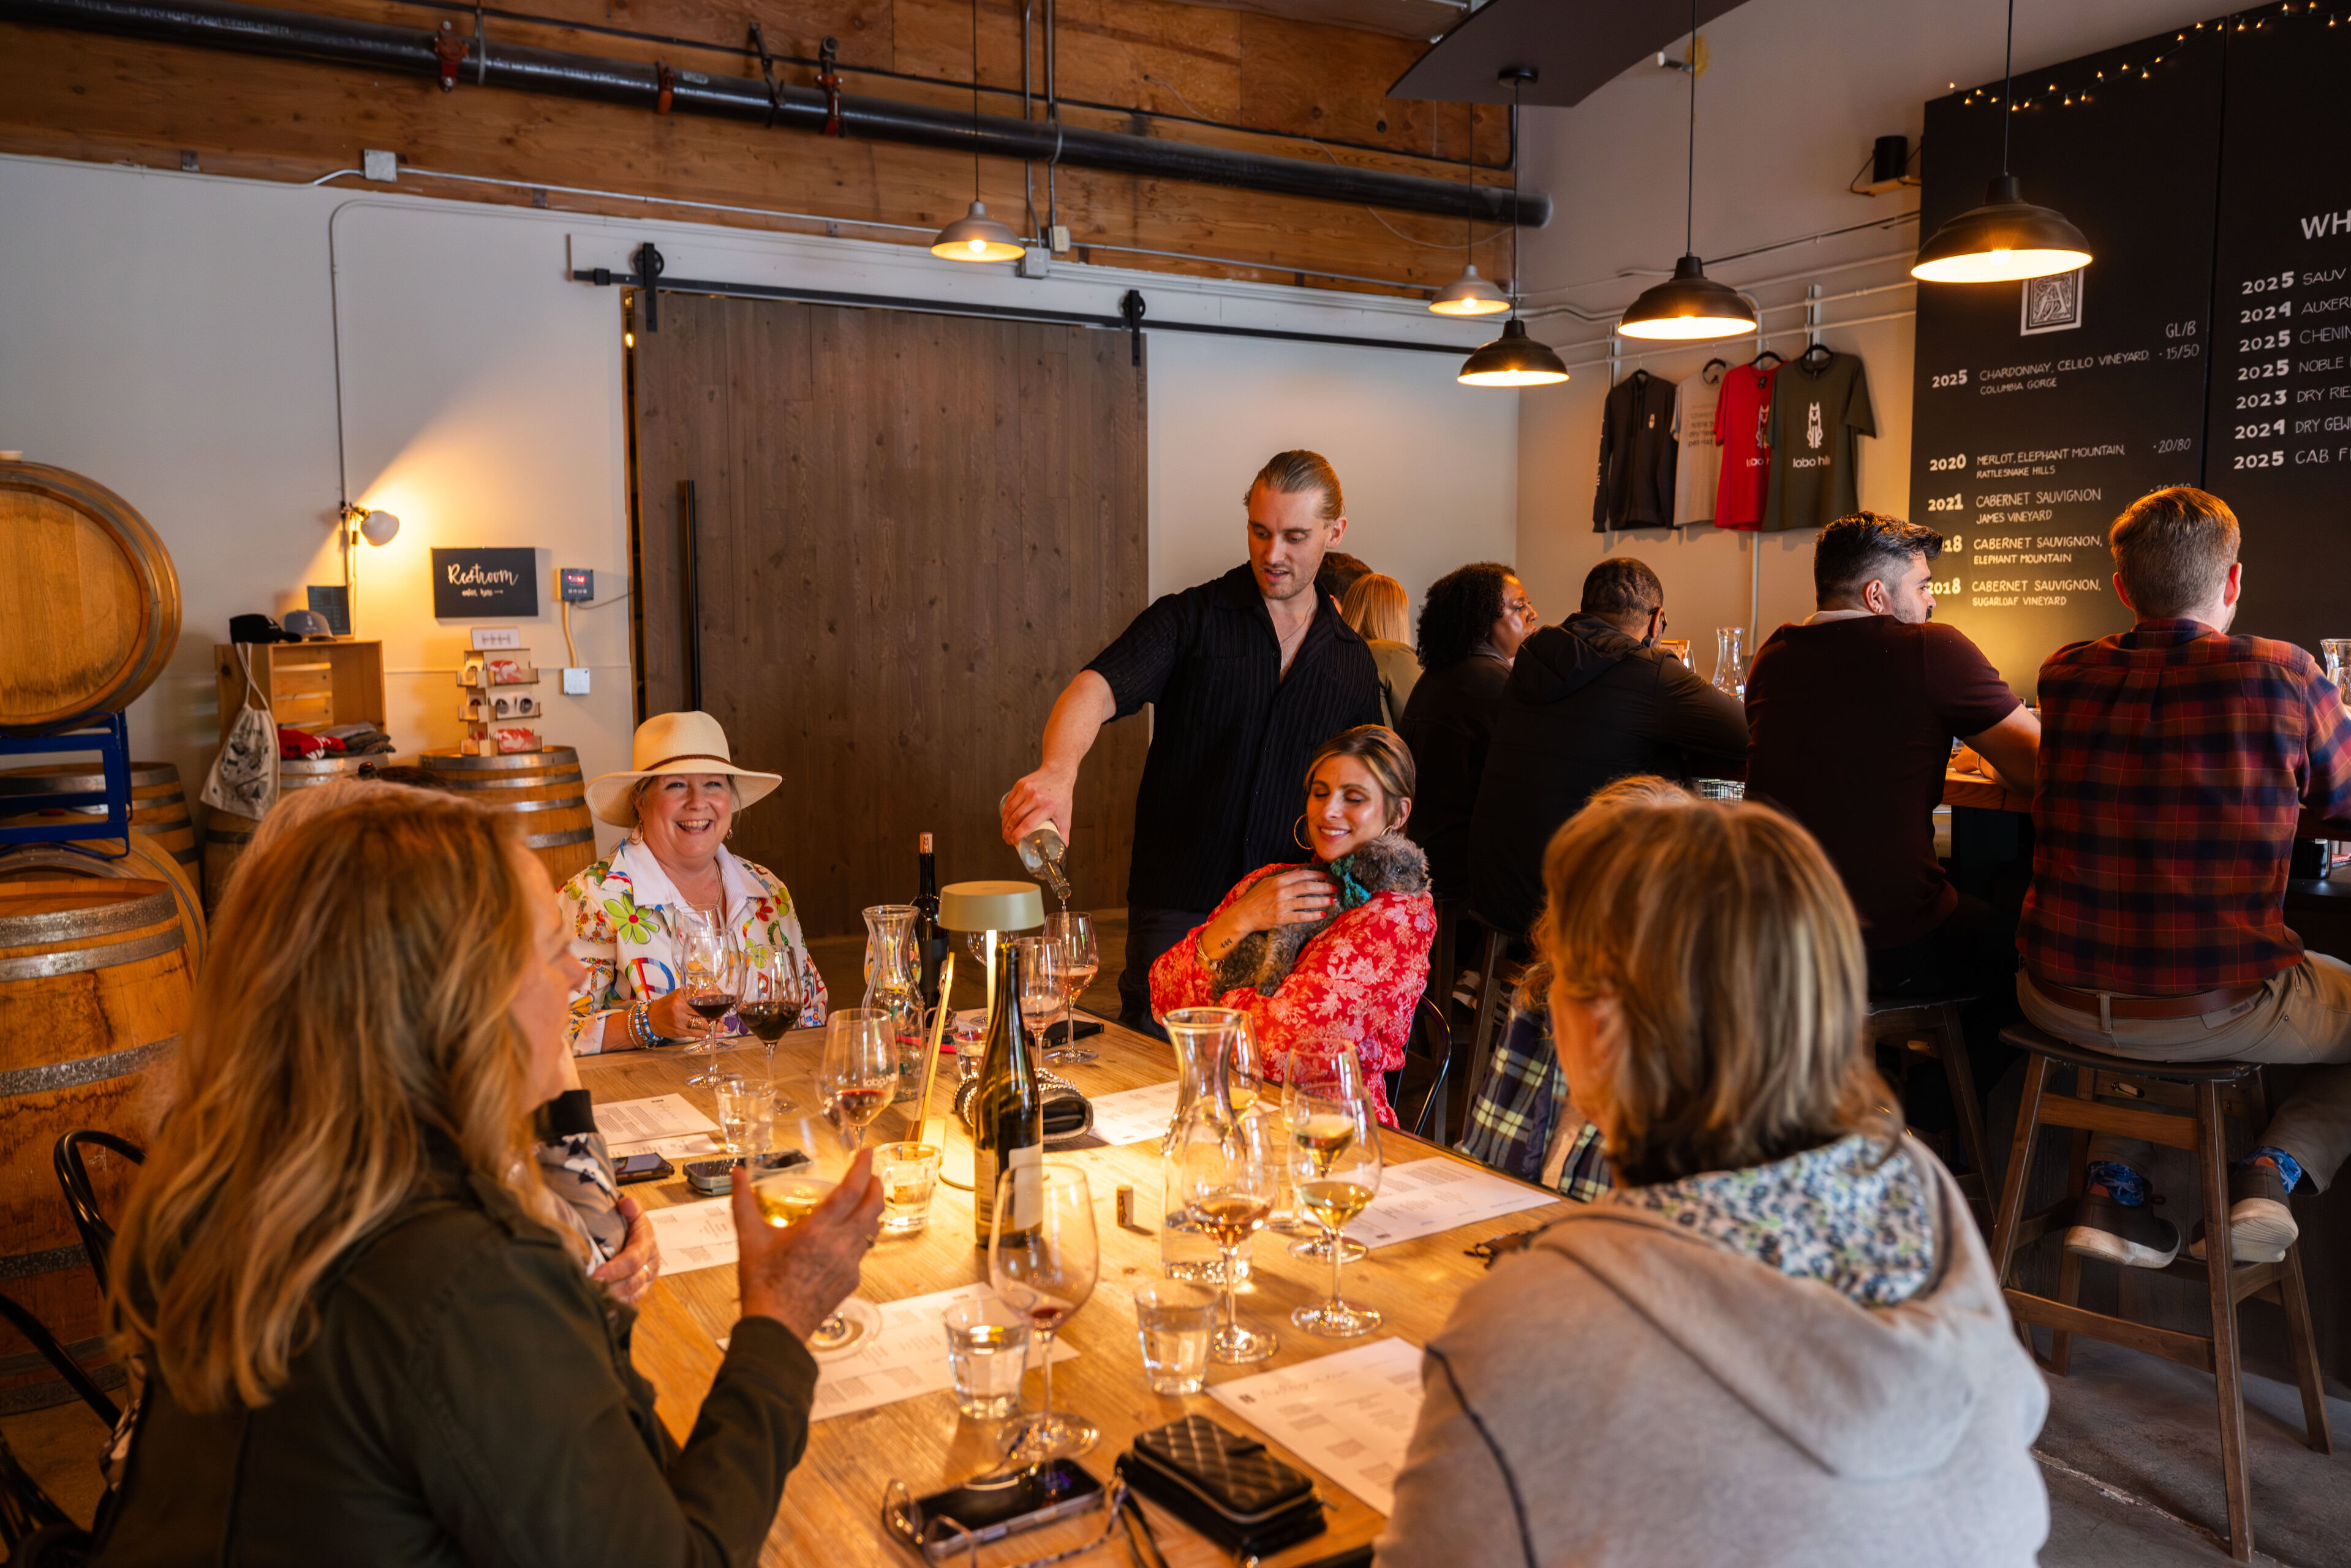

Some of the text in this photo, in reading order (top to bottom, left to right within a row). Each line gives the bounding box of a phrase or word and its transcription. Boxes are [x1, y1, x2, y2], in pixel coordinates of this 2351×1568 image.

[2242, 268, 2346, 295] 2025 SAUV
[2241, 296, 2351, 323] 2024 AUXER
[2165, 320, 2196, 338] GL/B
[2240, 330, 2290, 352] 2025
[1932, 369, 1968, 388] 2025
[2058, 357, 2094, 372] CELILO
[2166, 344, 2200, 360] 15/50
[2238, 356, 2344, 380] 2025 NOBLE
[1980, 377, 2058, 395] COLUMBIA GORGE
[2236, 385, 2351, 409] 2023 DRY RIE
[2235, 419, 2285, 439] 2024
[2295, 418, 2320, 434] DRY
[1792, 457, 1816, 468] lobo
[1930, 453, 1967, 471] 2020
[2018, 448, 2070, 463] ELEPHANT
[2158, 438, 2191, 453] 20/80
[2233, 450, 2284, 470] 2025
[1976, 465, 2056, 479] RATTLESNAKE HILLS
[1928, 488, 2102, 511] 2021 CABERNET SAUVIGNON
[1976, 510, 2052, 524] JAMES VINEYARD
[1943, 535, 1963, 552] 18
[1973, 537, 2032, 550] CABERNET
[1974, 554, 2072, 565] ELEPHANT MOUNTAIN
[448, 562, 519, 586] Restroom
[1928, 577, 1961, 595] 2018
[1971, 580, 2028, 592] CABERNET
[1972, 596, 2067, 606] SUGARLOAF VINEYARD
